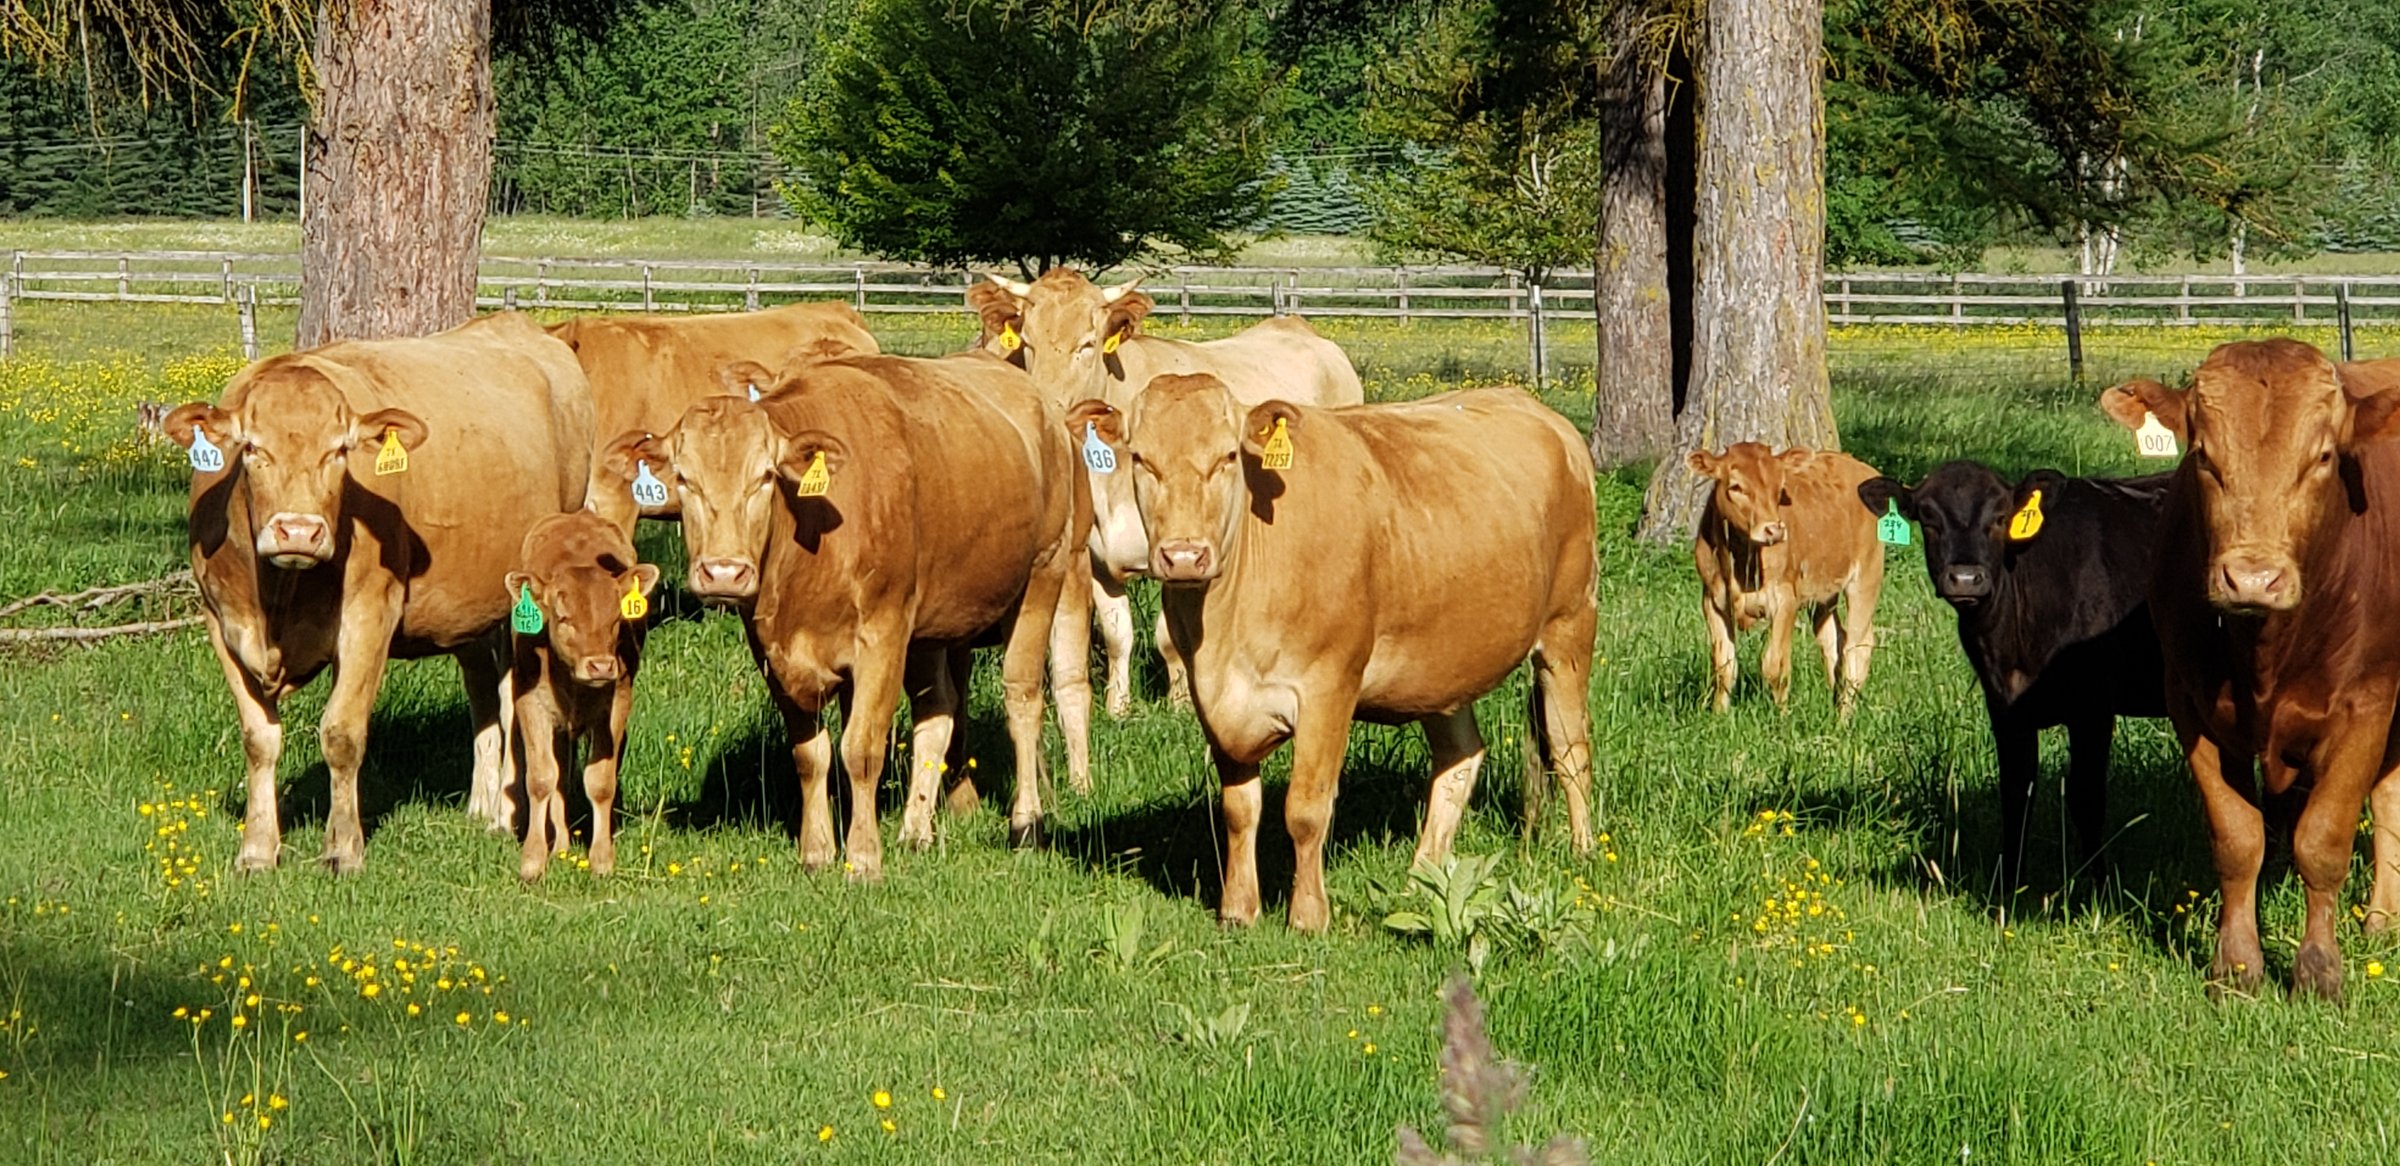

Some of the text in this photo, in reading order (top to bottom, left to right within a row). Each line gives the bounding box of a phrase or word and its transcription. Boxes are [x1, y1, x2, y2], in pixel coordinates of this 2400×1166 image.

[193, 449, 221, 466] 442
[1086, 448, 1113, 468] 436
[636, 483, 665, 501] 443
[628, 599, 641, 615] 16
[521, 620, 531, 631] 16
